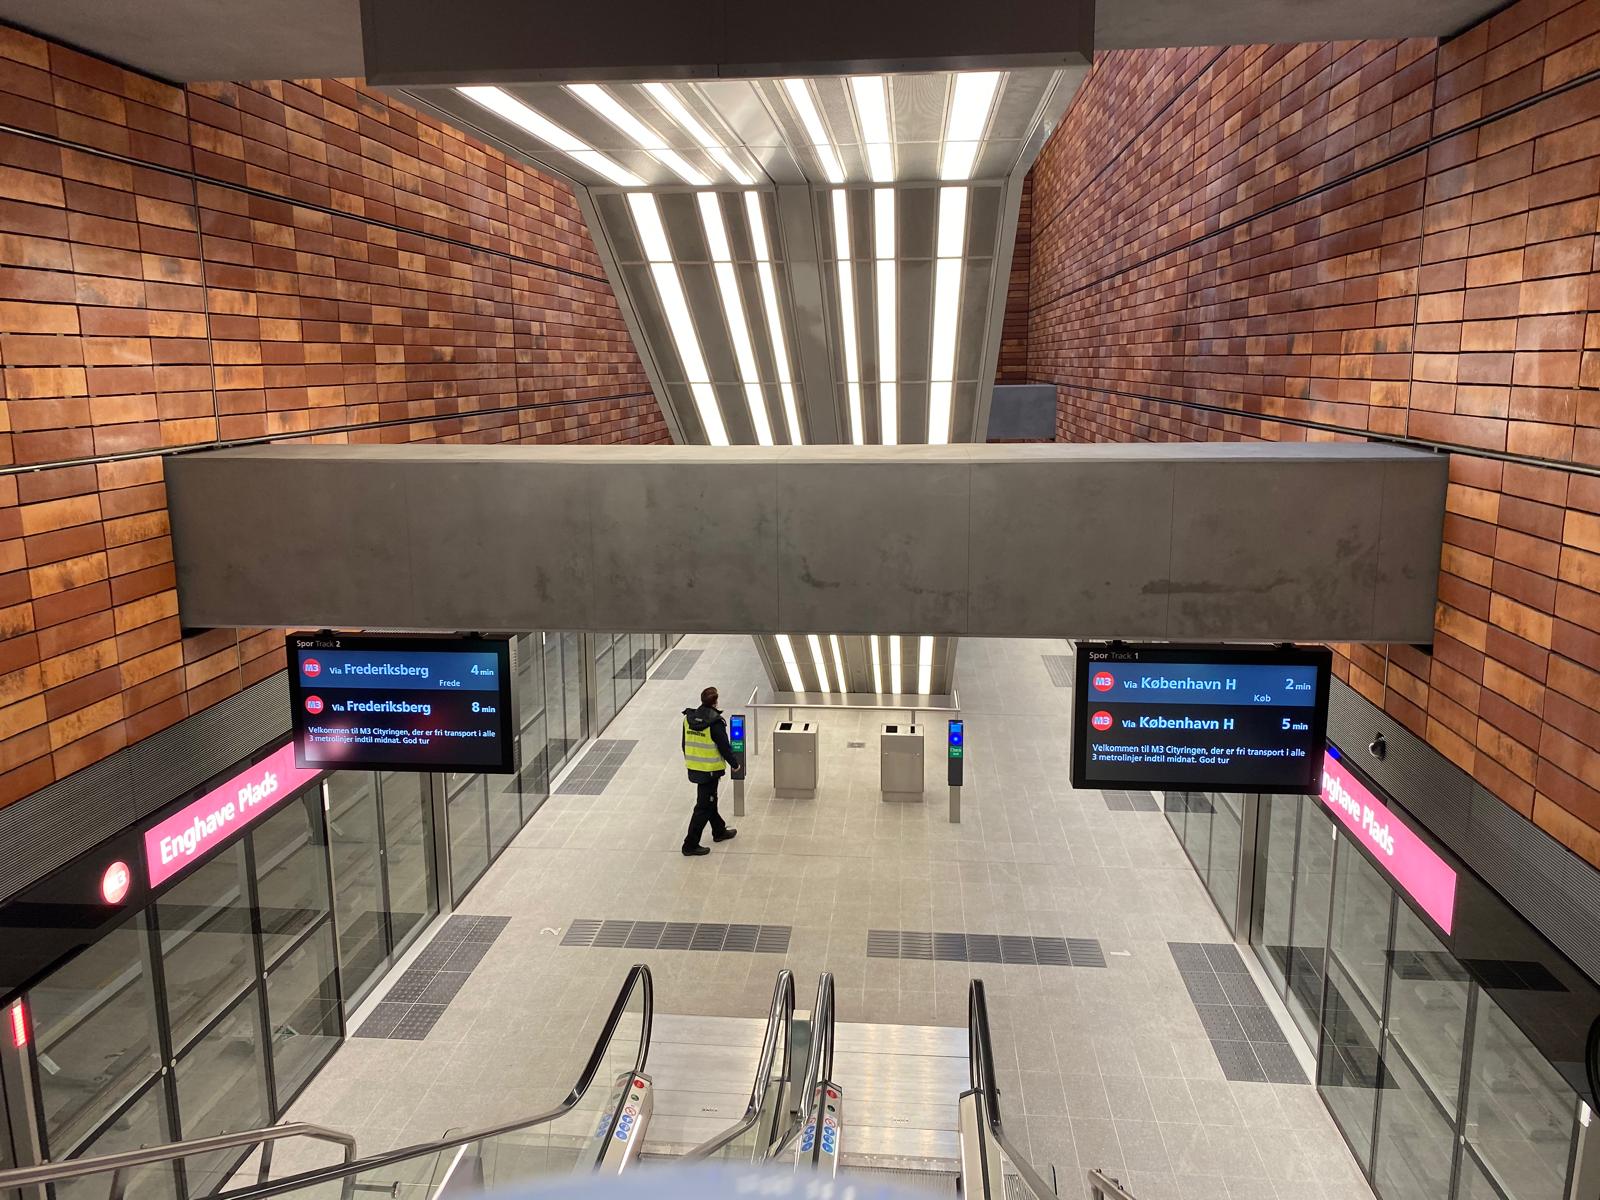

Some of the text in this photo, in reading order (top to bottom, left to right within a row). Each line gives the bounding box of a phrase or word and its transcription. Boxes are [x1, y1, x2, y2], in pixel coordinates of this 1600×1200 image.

[296, 640, 314, 648] Spor
[1089, 651, 1139, 660] Spor Track 1
[305, 664, 319, 672] M3
[329, 663, 429, 679] Via Frederiksberg
[470, 664, 494, 676] 4 min
[439, 679, 461, 687] Frede
[1095, 677, 1112, 686] M3
[1123, 677, 1237, 690] Via København H
[1285, 678, 1311, 691] 2 min
[307, 700, 321, 709] M3
[331, 700, 431, 716] Via Frederiksberg
[471, 701, 496, 713] 8 min
[1094, 716, 1110, 726] M3
[1121, 716, 1234, 730] Via København H
[1281, 718, 1309, 730] 5 min
[308, 726, 350, 735] Velkommen
[350, 727, 359, 735] til
[359, 727, 372, 735] M3
[372, 727, 411, 737] Cityringen,
[434, 729, 444, 737] fri
[444, 730, 477, 739] transport
[482, 730, 496, 738] alle
[309, 734, 314, 742] 3
[315, 735, 353, 744] metrolinjer
[354, 735, 373, 743] indtil
[374, 736, 402, 744] midnat.
[1092, 743, 1139, 752] Velkommen
[1141, 745, 1150, 753] til
[1151, 745, 1164, 753] M3
[1165, 746, 1209, 755] Cityringen,
[1210, 747, 1224, 755] der
[1236, 747, 1246, 756] fri
[1247, 748, 1285, 758] transport
[1290, 749, 1306, 757] alle
[1092, 753, 1098, 761] 3
[1098, 754, 1142, 763] metrolinjer
[1144, 754, 1165, 763] indtil
[1166, 756, 1198, 764] midnat.
[1199, 756, 1216, 764] God
[159, 771, 279, 865] Enghave Plads
[1322, 769, 1394, 856] nghave Plads
